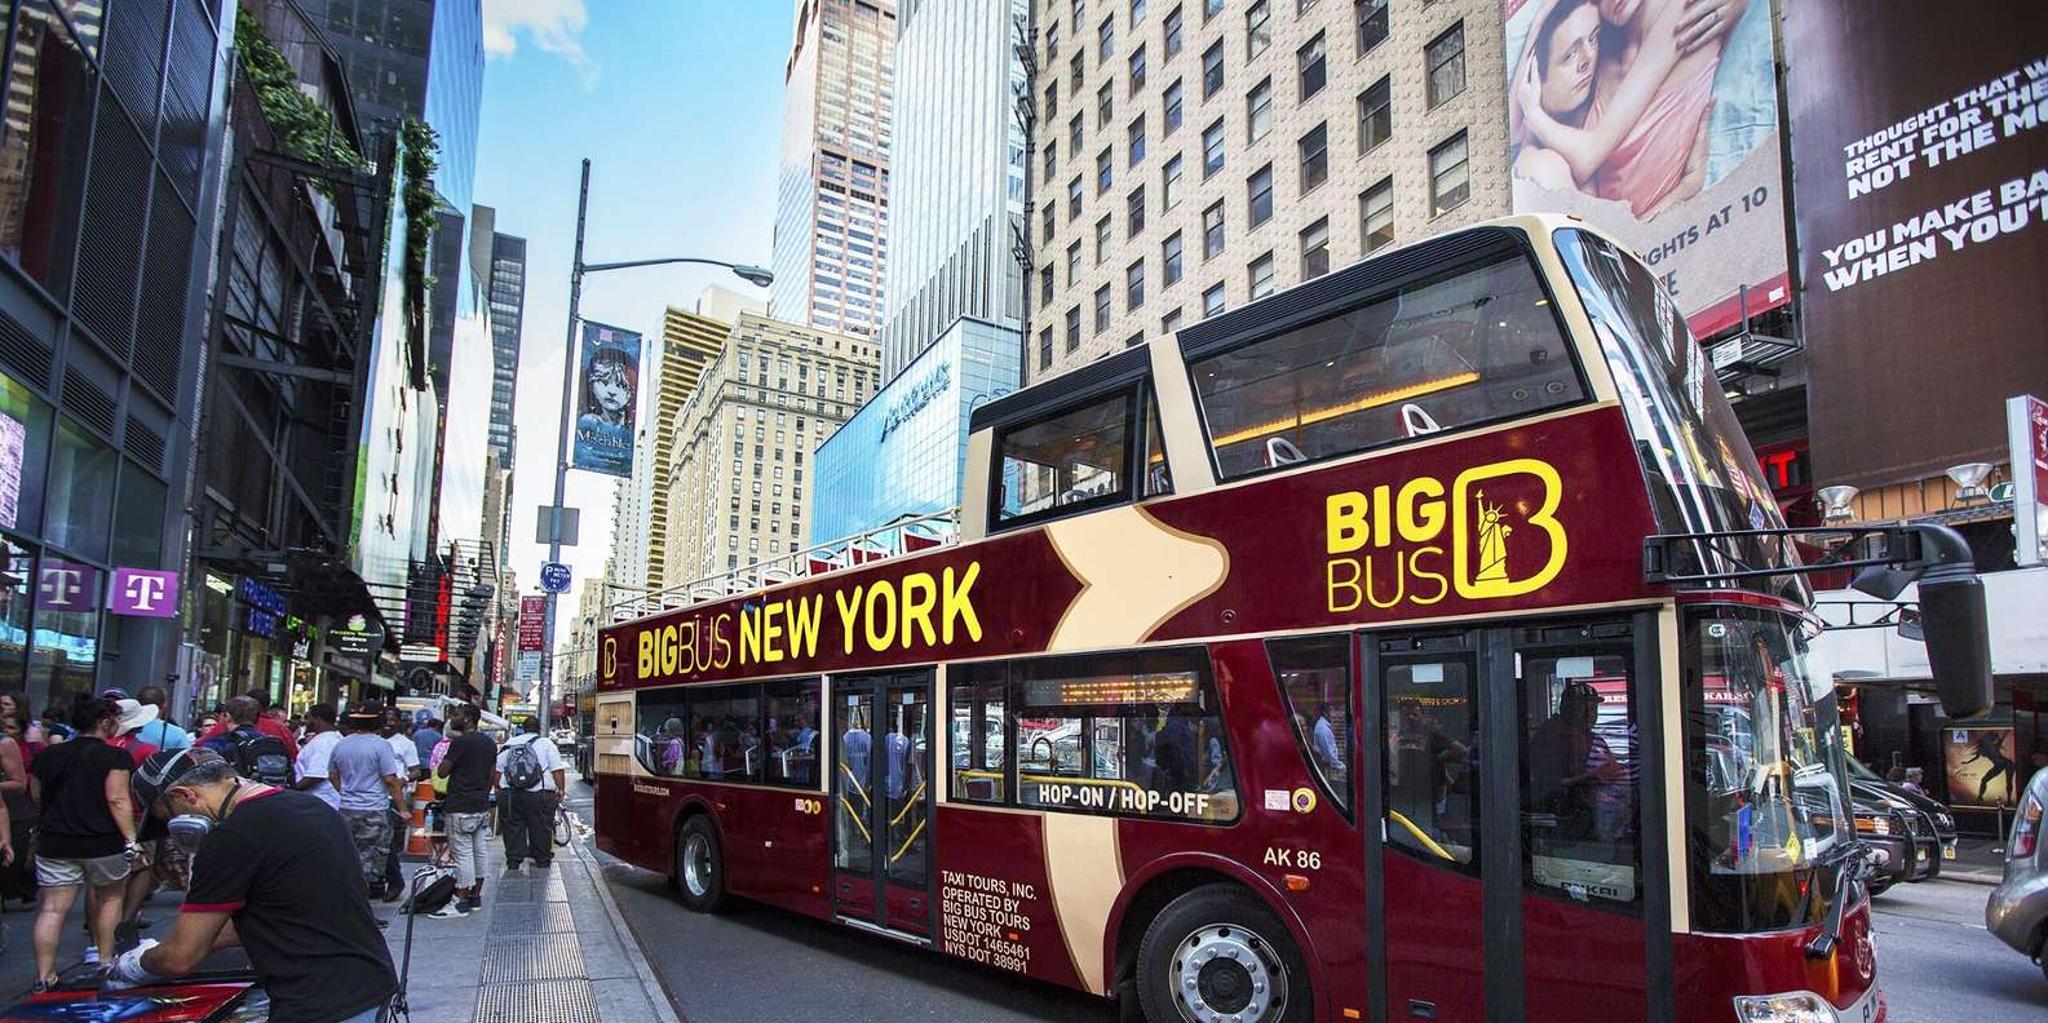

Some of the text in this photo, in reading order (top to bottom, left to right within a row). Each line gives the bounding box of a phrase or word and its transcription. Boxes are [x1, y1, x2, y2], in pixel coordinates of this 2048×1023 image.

[1844, 102, 1950, 158] THOUGHT
[1953, 70, 2020, 110] THAT
[1846, 77, 2048, 178] RENT FOR THE
[1847, 154, 1916, 200] NOT
[1922, 121, 1996, 168] THE
[1706, 204, 1732, 235] AT
[1741, 186, 1768, 213] 10
[1821, 229, 1886, 267] YOU
[1892, 190, 1993, 244] MAKE
[1823, 195, 2048, 292] WHEN YOU'
[1326, 476, 1446, 554] BIG
[126, 574, 165, 610] T
[1328, 547, 1448, 612] BUS
[740, 593, 823, 665] NEW
[835, 560, 982, 655] YORK
[1038, 784, 1104, 807] HOP-ON
[1121, 789, 1209, 815] HOP-OFF
[1263, 846, 1320, 869] AK 86
[942, 870, 1037, 900] TAXI TOURS, INC.
[942, 886, 1019, 913] OPERATED BY
[943, 900, 1030, 931] BIG BUS TOURS
[943, 913, 1002, 938] NEW YORK
[944, 927, 1030, 960] USDOT 1465461
[945, 940, 1027, 974] NYS DOT 38991
